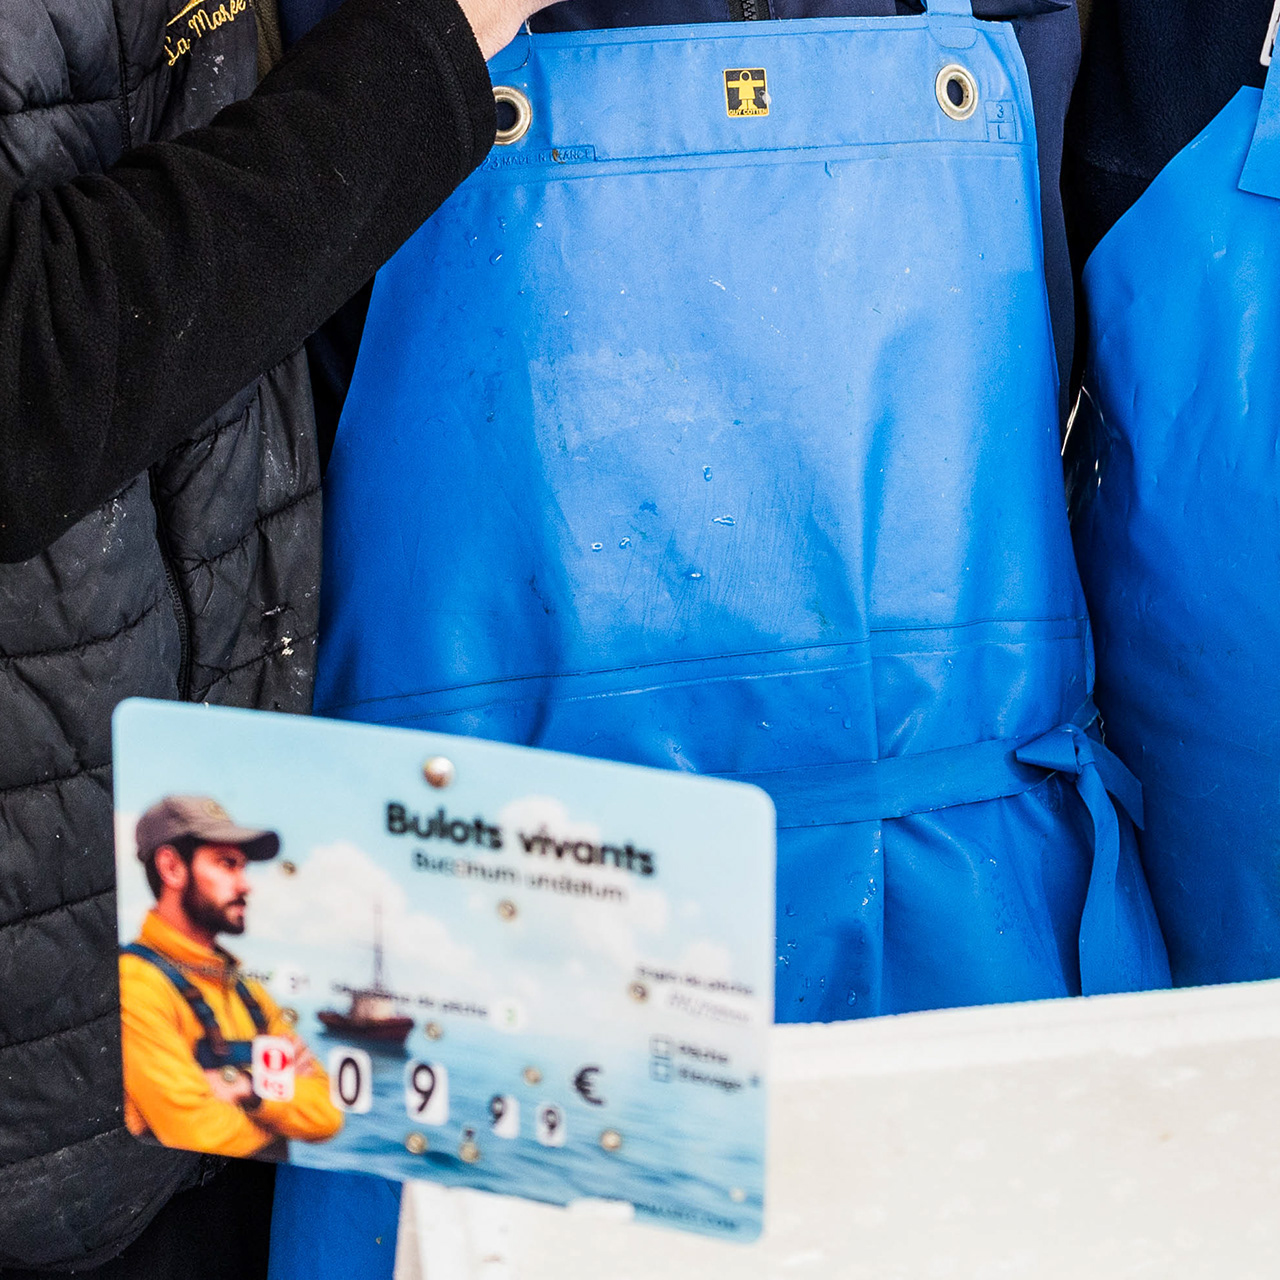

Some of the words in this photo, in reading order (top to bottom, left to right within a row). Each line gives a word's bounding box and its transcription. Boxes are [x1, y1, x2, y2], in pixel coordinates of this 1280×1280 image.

[164, 36, 191, 66] La
[386, 801, 504, 849] Bulots
[517, 827, 658, 876] vivants
